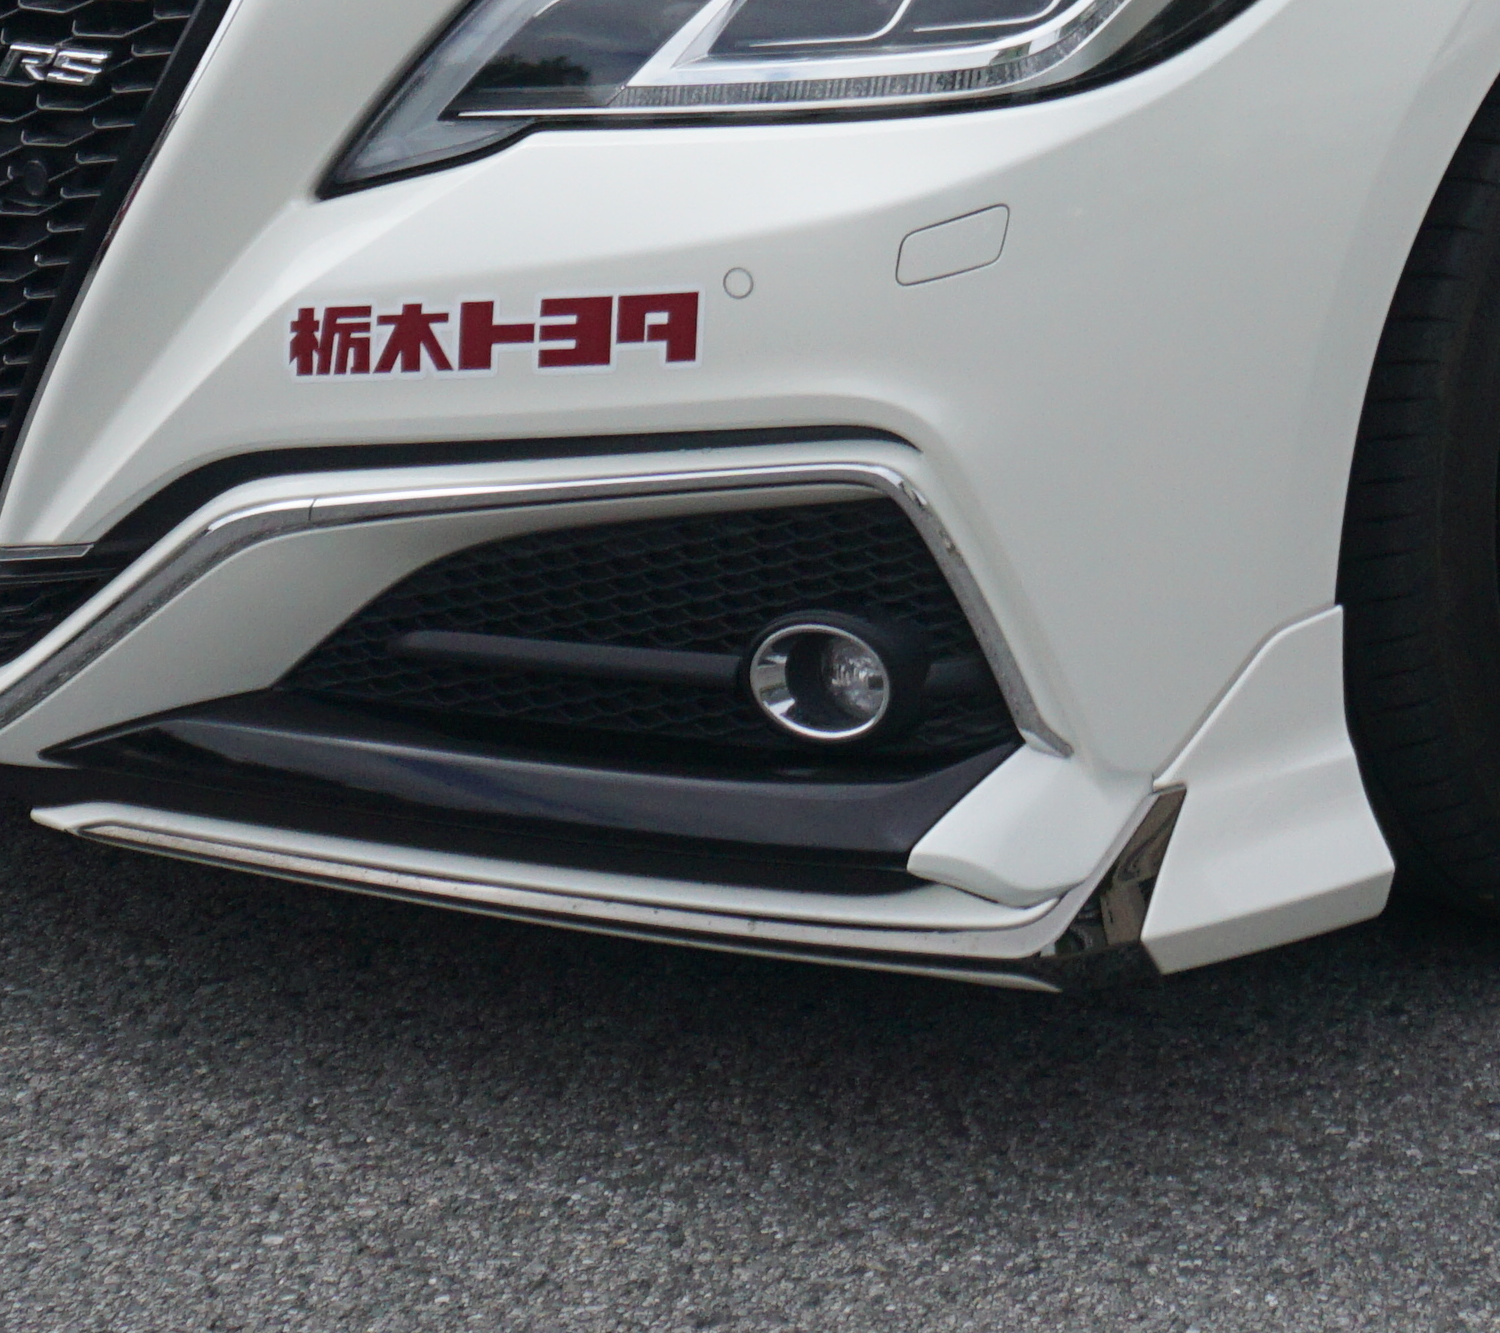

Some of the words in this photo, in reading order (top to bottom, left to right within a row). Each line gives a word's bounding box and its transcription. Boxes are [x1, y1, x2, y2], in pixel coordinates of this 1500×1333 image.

[0, 44, 111, 86] RS
[289, 291, 700, 376] 栃木トヨタ
